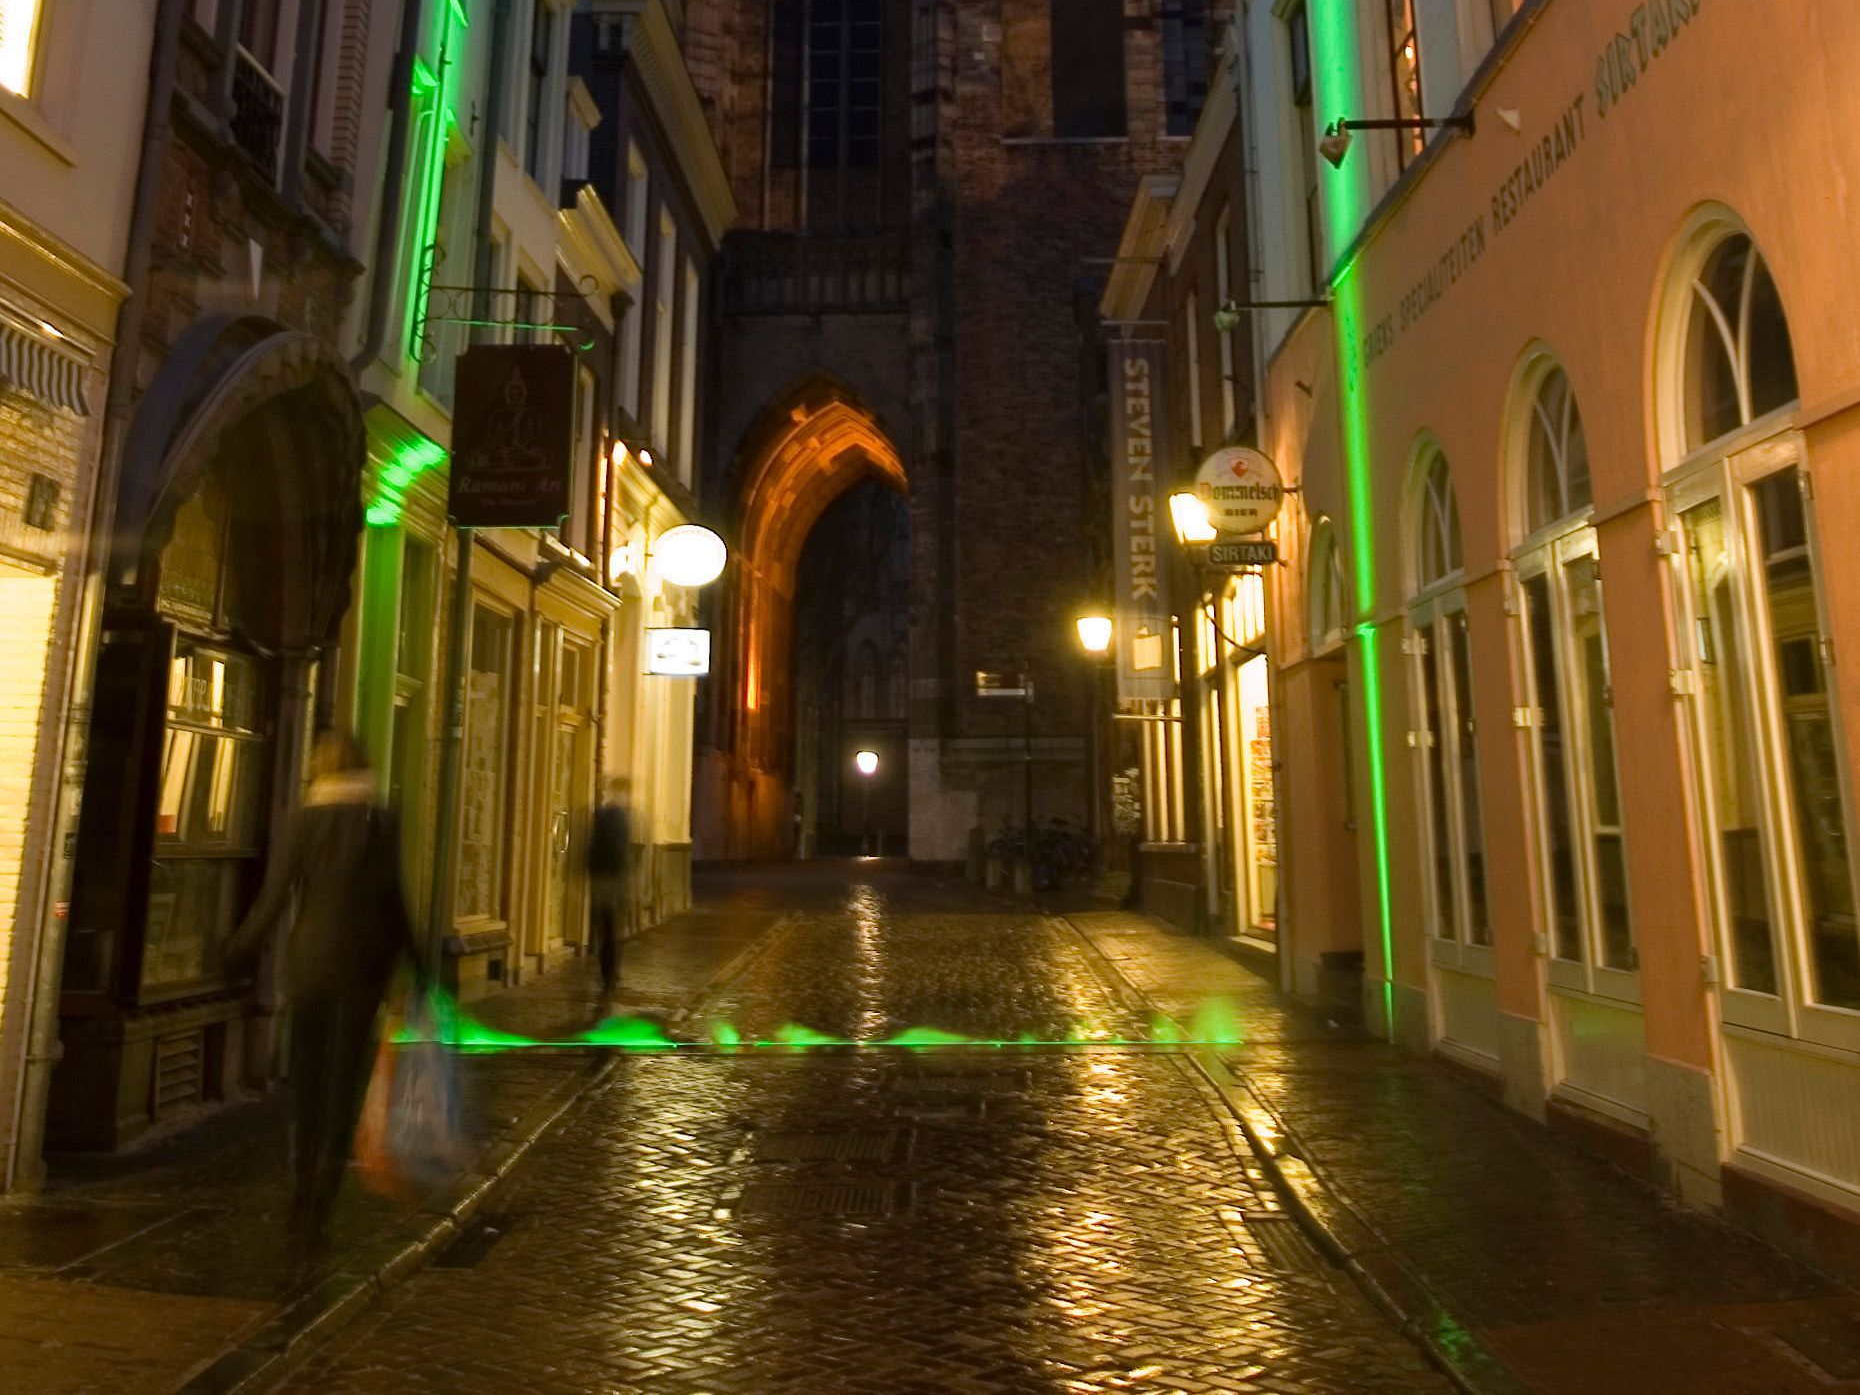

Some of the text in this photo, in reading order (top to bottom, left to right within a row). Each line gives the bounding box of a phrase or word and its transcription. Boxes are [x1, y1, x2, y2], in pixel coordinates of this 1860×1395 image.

[1490, 92, 1586, 237] RESTAURANT
[1123, 357, 1157, 600] STEVEN STERK
[1224, 508, 1258, 517] BIER
[1211, 545, 1274, 562] SIRTAKI
